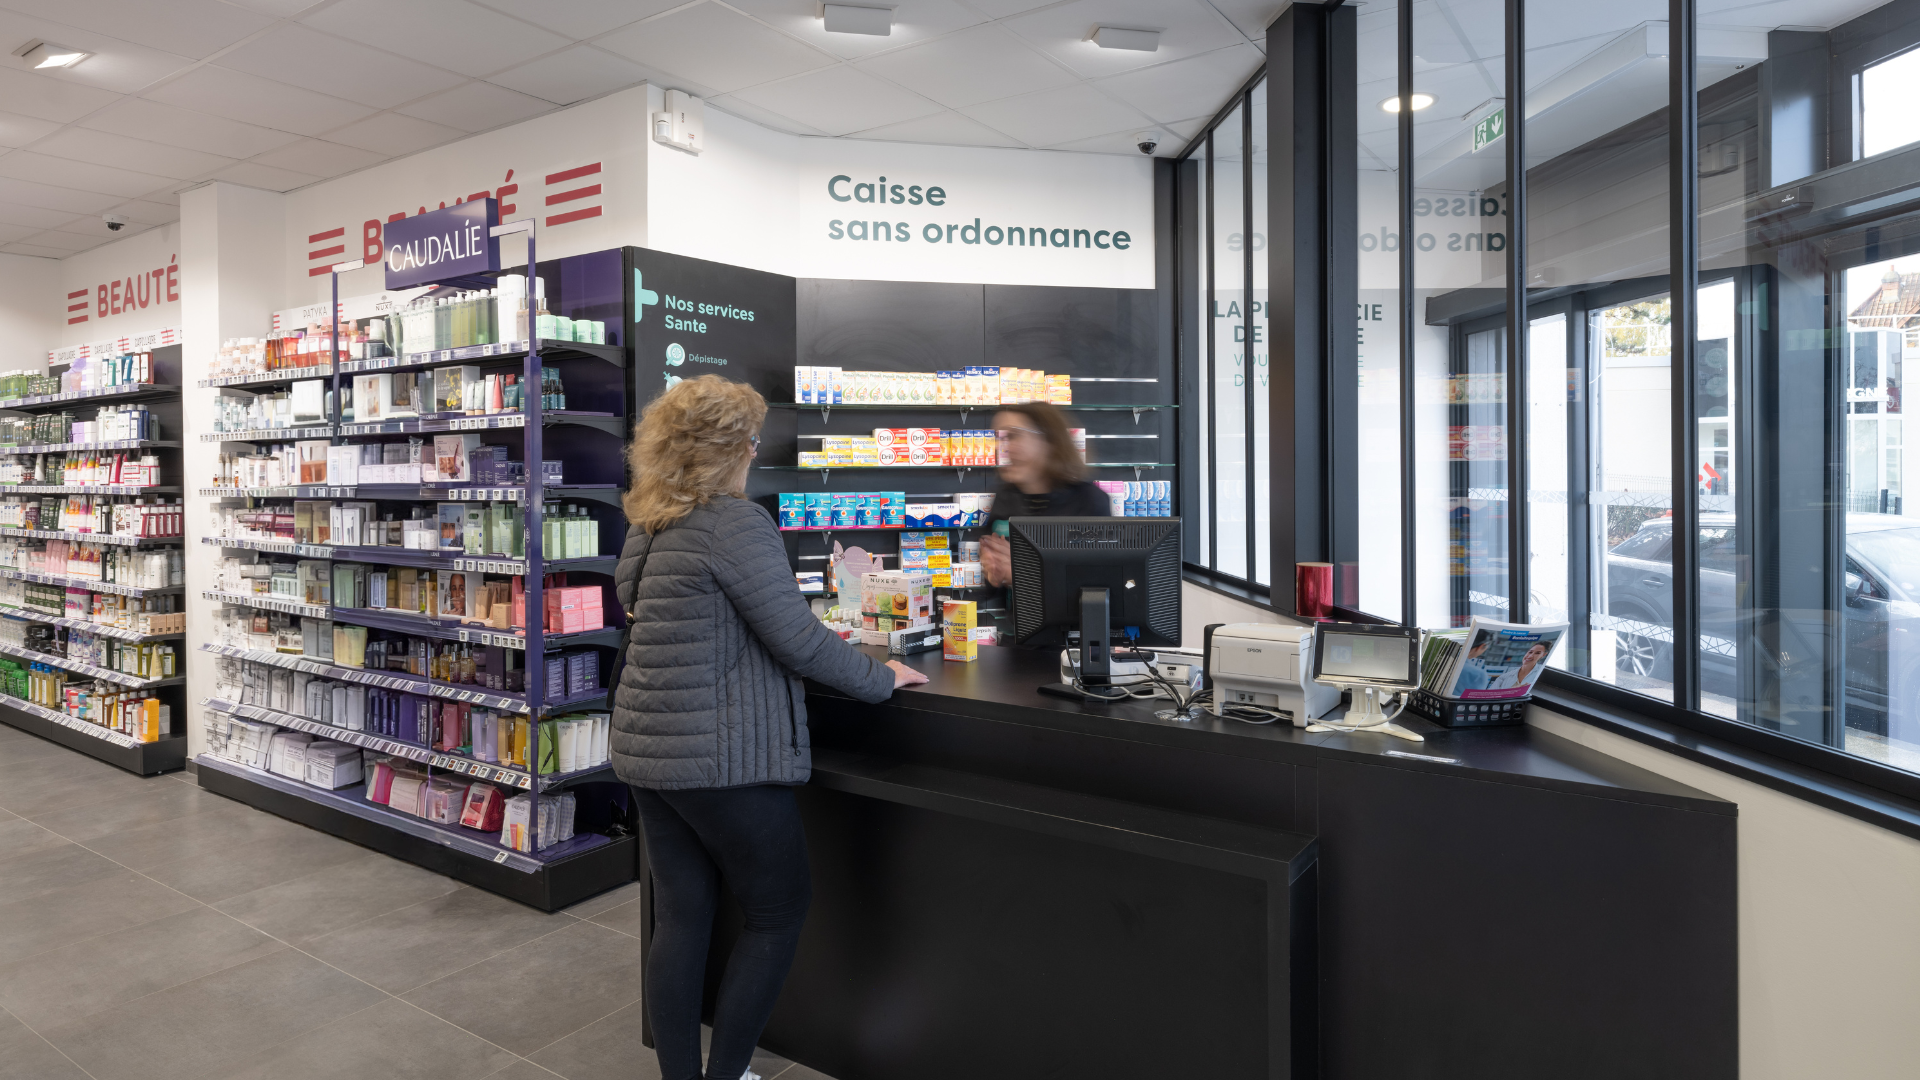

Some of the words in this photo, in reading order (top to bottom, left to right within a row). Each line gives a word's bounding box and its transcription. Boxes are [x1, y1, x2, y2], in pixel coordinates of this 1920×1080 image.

[828, 174, 946, 206] Caisse
[828, 219, 911, 242] sans
[922, 218, 1132, 250] ordonnance
[97, 253, 179, 318] BEAUTÉ
[303, 306, 328, 320] PATYKA
[665, 294, 694, 312] Nos
[698, 302, 755, 322] services
[664, 315, 707, 334] Sante
[688, 353, 728, 366] Dépistage
[943, 619, 967, 628] Doliprane
